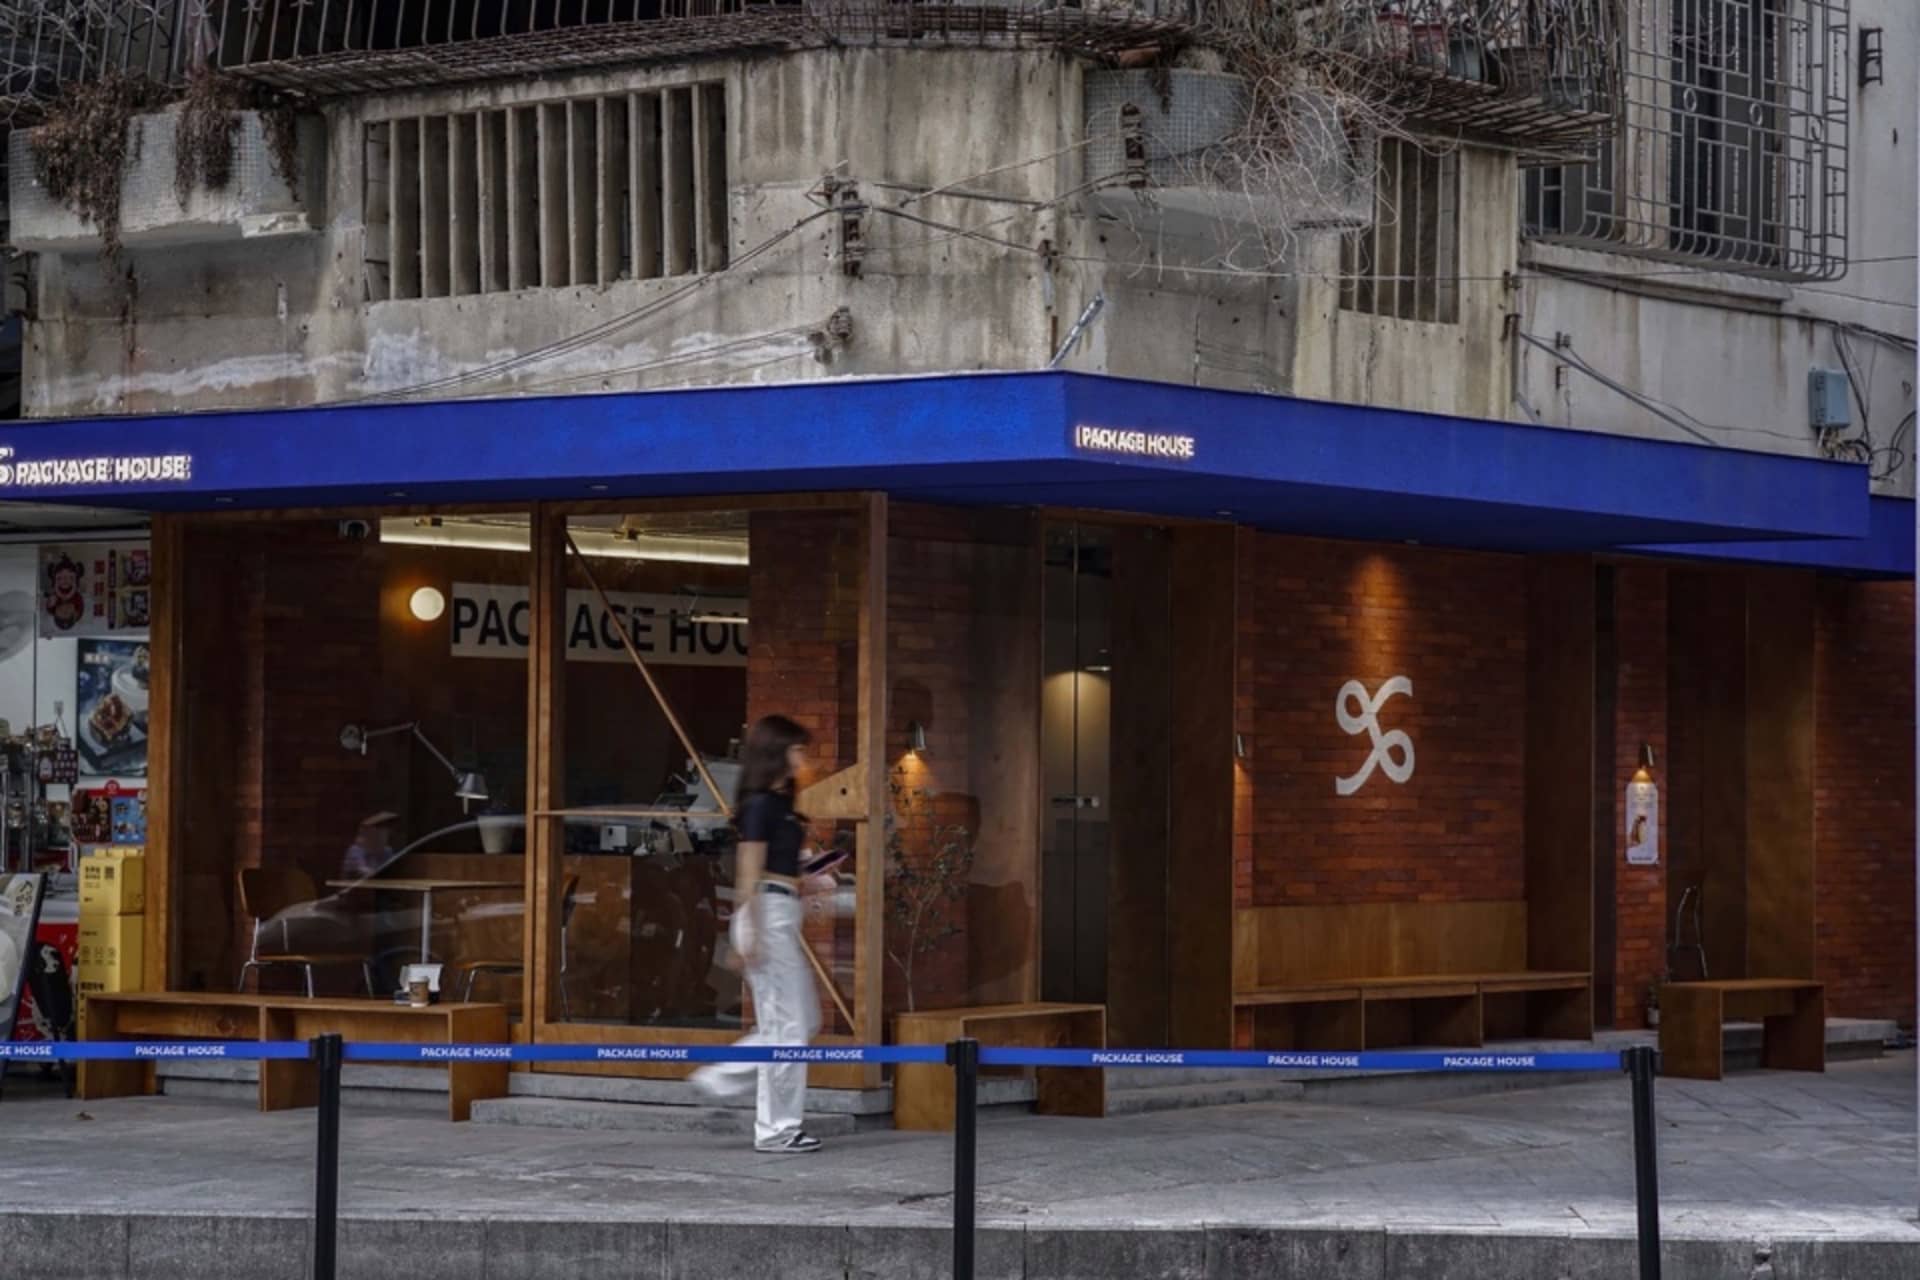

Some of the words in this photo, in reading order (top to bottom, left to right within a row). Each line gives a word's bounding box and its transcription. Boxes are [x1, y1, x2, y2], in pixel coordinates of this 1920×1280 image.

[1082, 426, 1146, 453] PACKAGE
[1147, 434, 1195, 457] HOUSE
[15, 458, 112, 487] PACKAGE
[114, 454, 191, 484] HOUSE
[452, 597, 654, 651] PACAGE
[669, 608, 748, 655] HOU
[15, 1045, 53, 1056] HOUSE
[135, 1045, 185, 1056] PACKAGE
[187, 1045, 225, 1056] HOUSE
[421, 1047, 470, 1057] PACKAGE
[473, 1047, 512, 1057] HOUSE
[597, 1048, 647, 1059] PACKAGE
[650, 1048, 688, 1059] HOUSE
[772, 1049, 822, 1060] PACKAGE
[825, 1049, 863, 1060] HOUSE
[1092, 1053, 1142, 1064] PACKAGE
[1145, 1053, 1184, 1064] HOUSE
[1267, 1055, 1318, 1066] PACKAGE
[1321, 1055, 1359, 1066] HOUSE
[1443, 1056, 1494, 1067] PACKAGE
[1497, 1056, 1535, 1067] HOUSE
